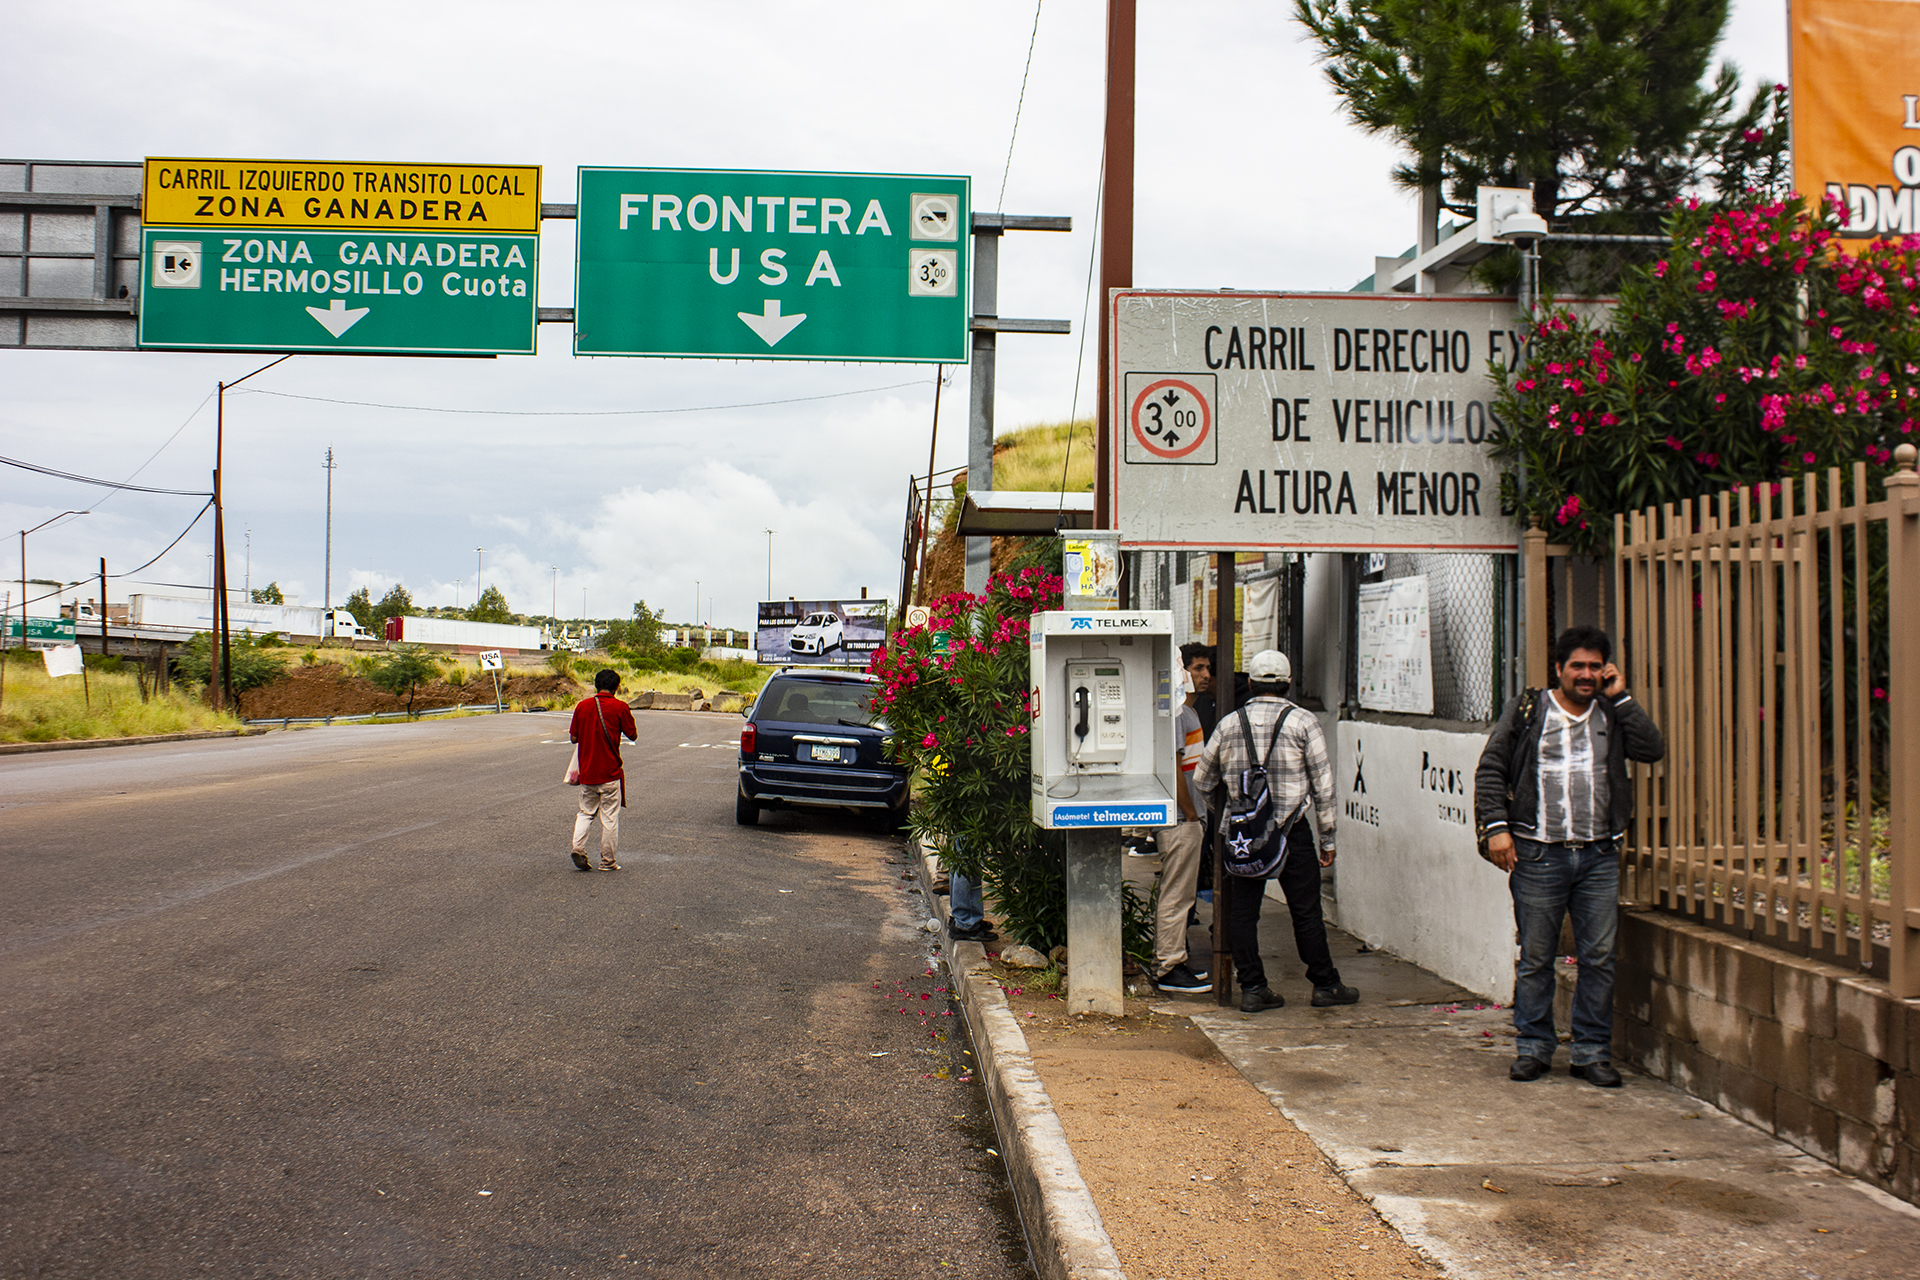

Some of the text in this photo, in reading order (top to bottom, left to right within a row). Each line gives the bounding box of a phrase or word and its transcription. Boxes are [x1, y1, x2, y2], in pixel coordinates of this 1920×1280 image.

[159, 168, 525, 196] CARRIL IZQUIERDO TRANSITO LOCAL
[194, 196, 488, 222] ZONA GANADERA
[619, 193, 892, 236] FRONTERA
[221, 239, 527, 268] ZONA GANADERA
[220, 268, 527, 297] HERMOSILLO Cuota
[1205, 325, 1315, 371] CARRIL
[1334, 328, 1470, 373] DERECHO
[1144, 402, 1163, 436] 3
[1272, 398, 1311, 442] DE
[1234, 469, 1358, 515] ALTURA
[1377, 471, 1481, 517] MENOR
[912, 612, 924, 622] 30
[1096, 618, 1148, 628] TELMEX
[481, 652, 500, 661] USA
[1093, 810, 1163, 822] telmex.com
[1345, 799, 1379, 828] NOGALES
